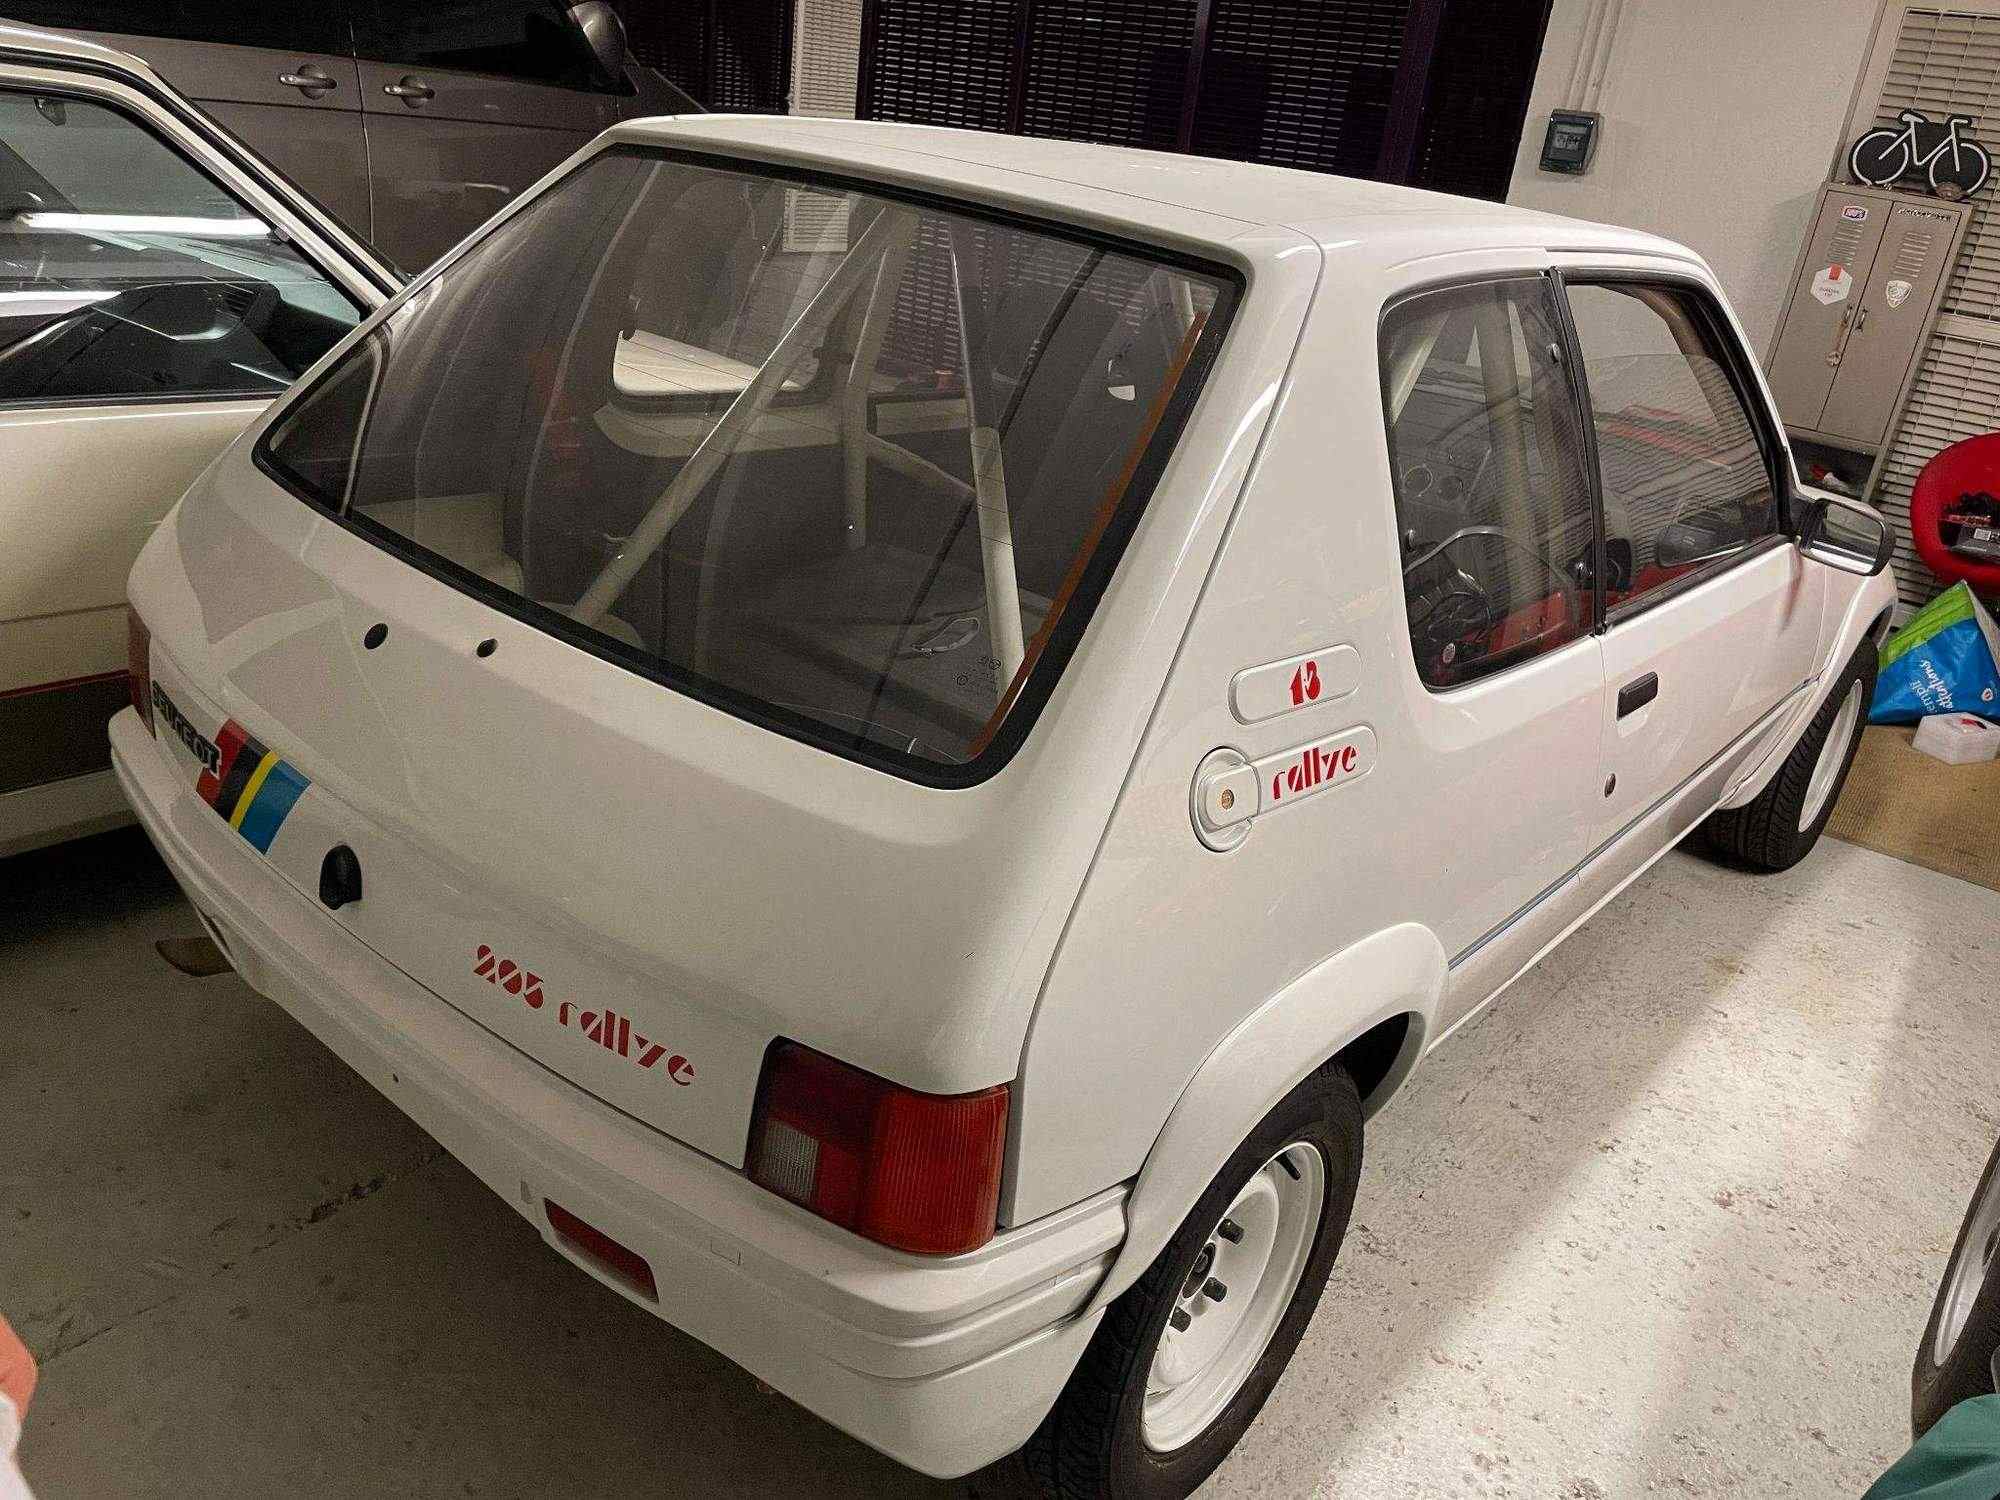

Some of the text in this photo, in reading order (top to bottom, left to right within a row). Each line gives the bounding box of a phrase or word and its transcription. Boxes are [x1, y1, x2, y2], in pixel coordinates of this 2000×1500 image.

[1272, 745, 1358, 801] rallye
[473, 944, 695, 1087] 205 rallye
